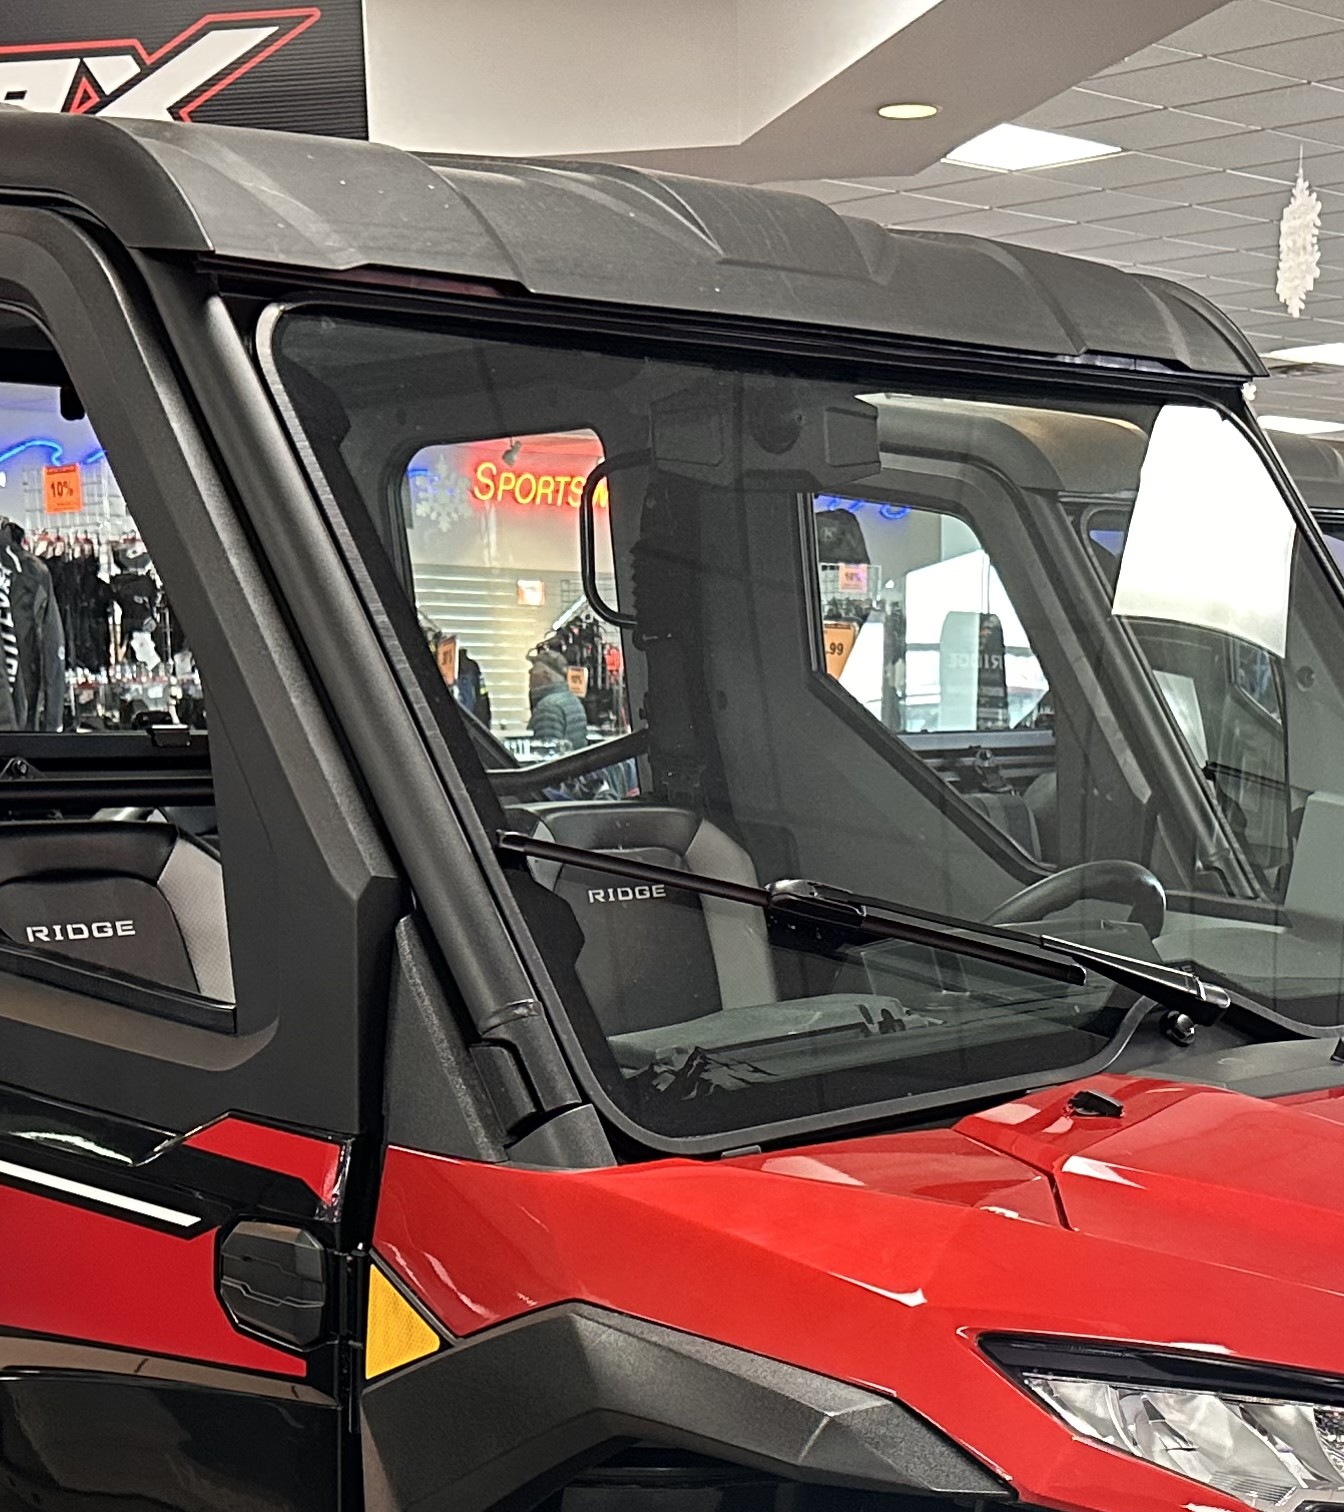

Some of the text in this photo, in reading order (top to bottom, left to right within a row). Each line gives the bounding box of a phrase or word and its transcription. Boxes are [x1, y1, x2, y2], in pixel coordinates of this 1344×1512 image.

[51, 481, 74, 498] 10%
[588, 884, 666, 904] RIDGE
[26, 919, 136, 943] RIDGE
